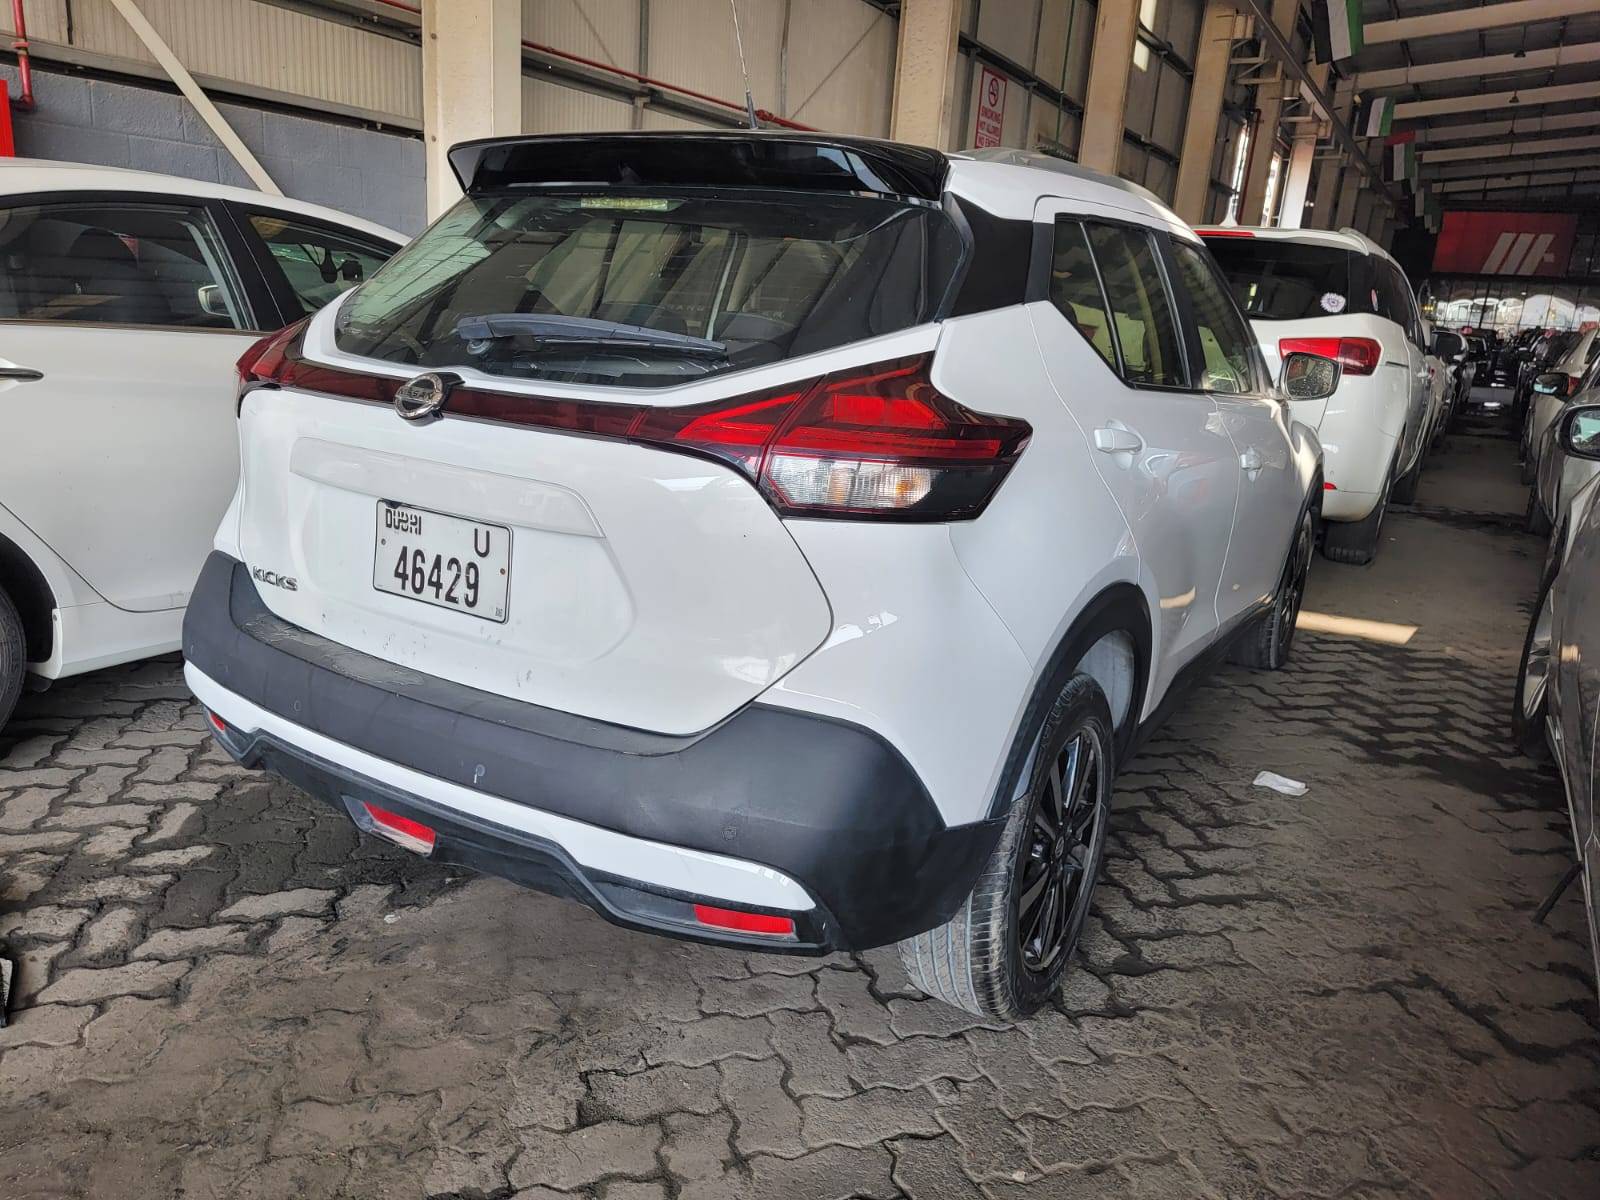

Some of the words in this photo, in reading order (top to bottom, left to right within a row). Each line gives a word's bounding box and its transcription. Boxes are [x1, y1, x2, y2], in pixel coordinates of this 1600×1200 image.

[981, 105, 1001, 124] SMOKING
[385, 508, 422, 536] DUBAI
[474, 528, 491, 558] U
[252, 565, 298, 592] KICKS
[394, 545, 480, 608] 46429
